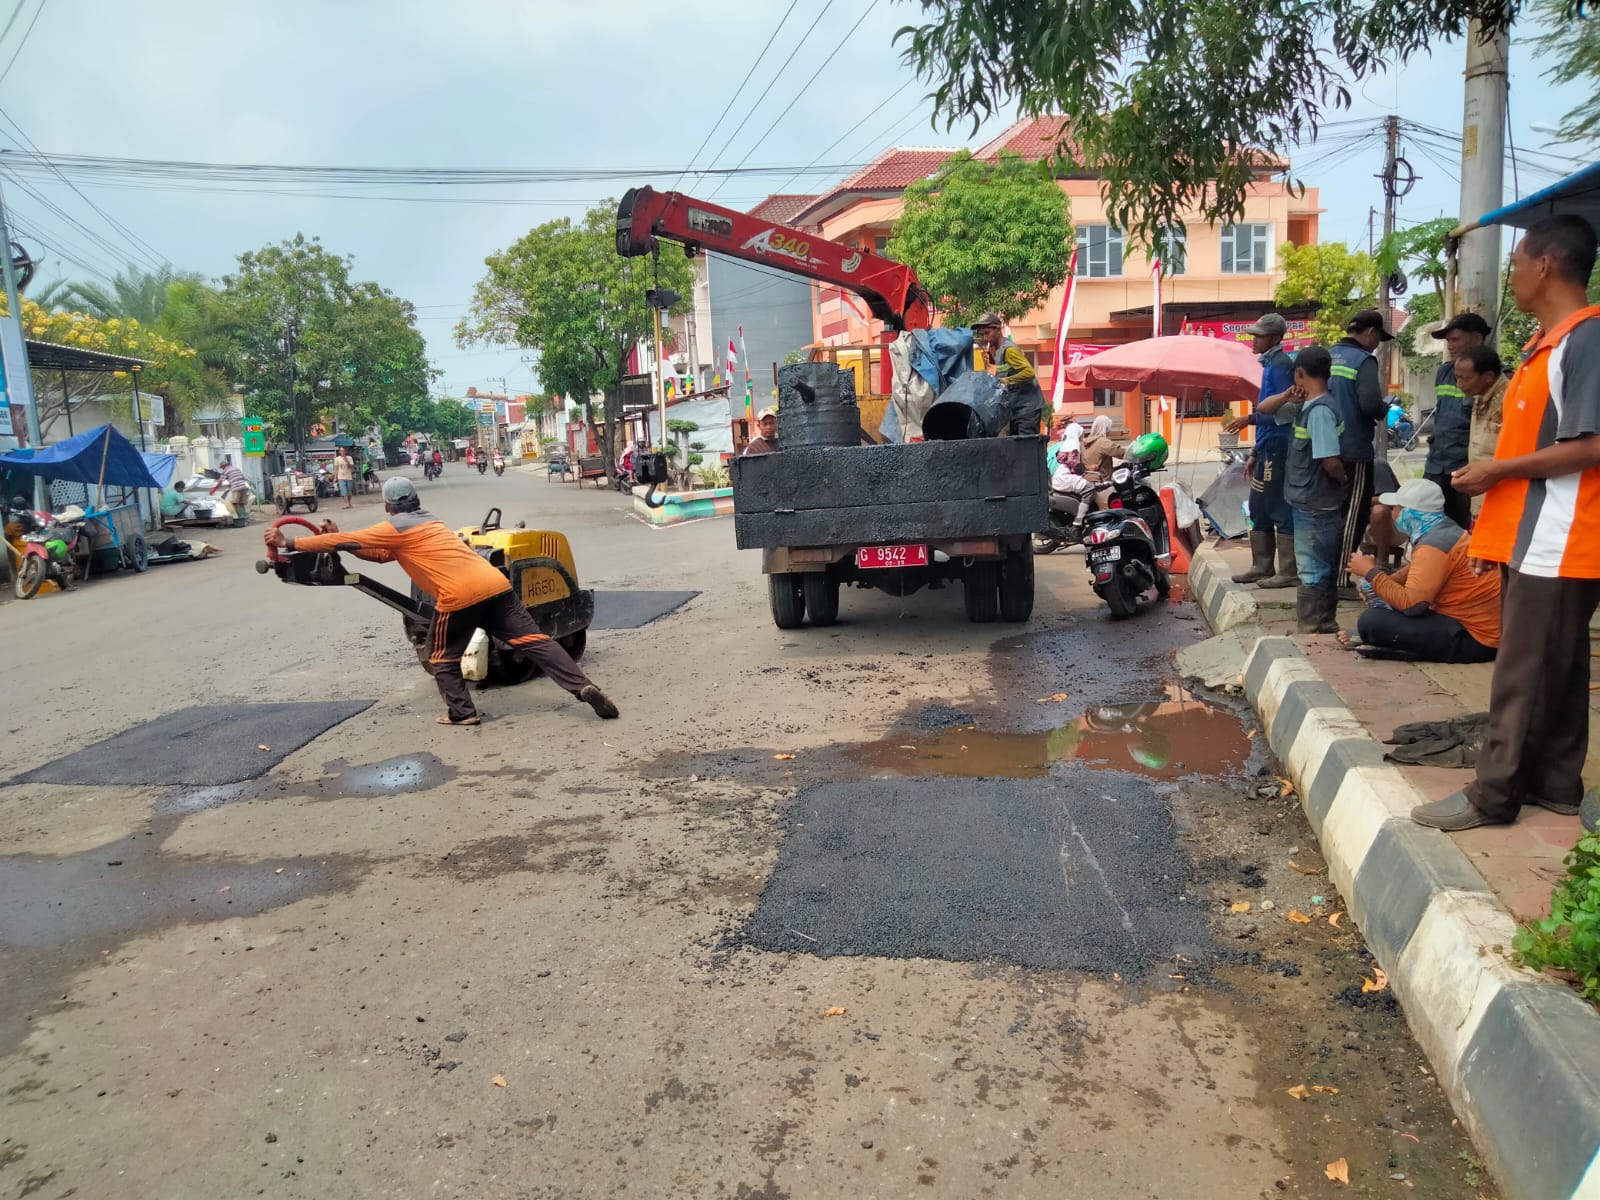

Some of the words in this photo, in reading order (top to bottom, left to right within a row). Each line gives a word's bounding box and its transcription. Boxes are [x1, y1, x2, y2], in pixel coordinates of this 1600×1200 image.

[860, 549, 868, 561] G
[878, 547, 906, 560] 9542
[918, 546, 924, 559] A
